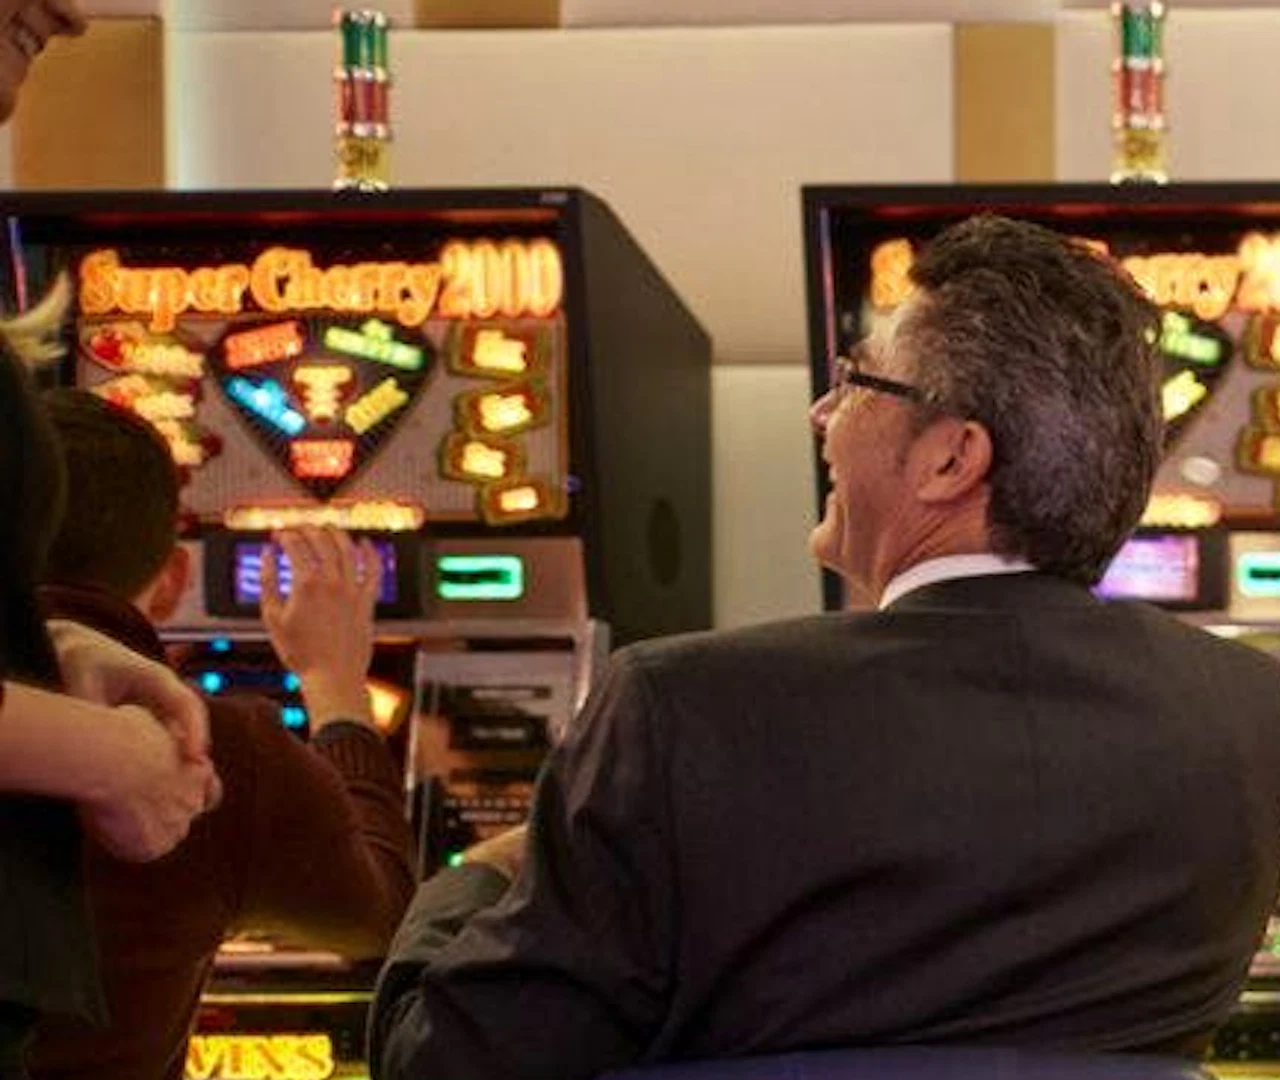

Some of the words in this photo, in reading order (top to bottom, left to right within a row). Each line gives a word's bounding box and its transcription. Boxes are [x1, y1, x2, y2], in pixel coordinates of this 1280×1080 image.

[80, 247, 250, 332] Super
[250, 246, 442, 326] Cherry
[440, 239, 563, 318] 2000
